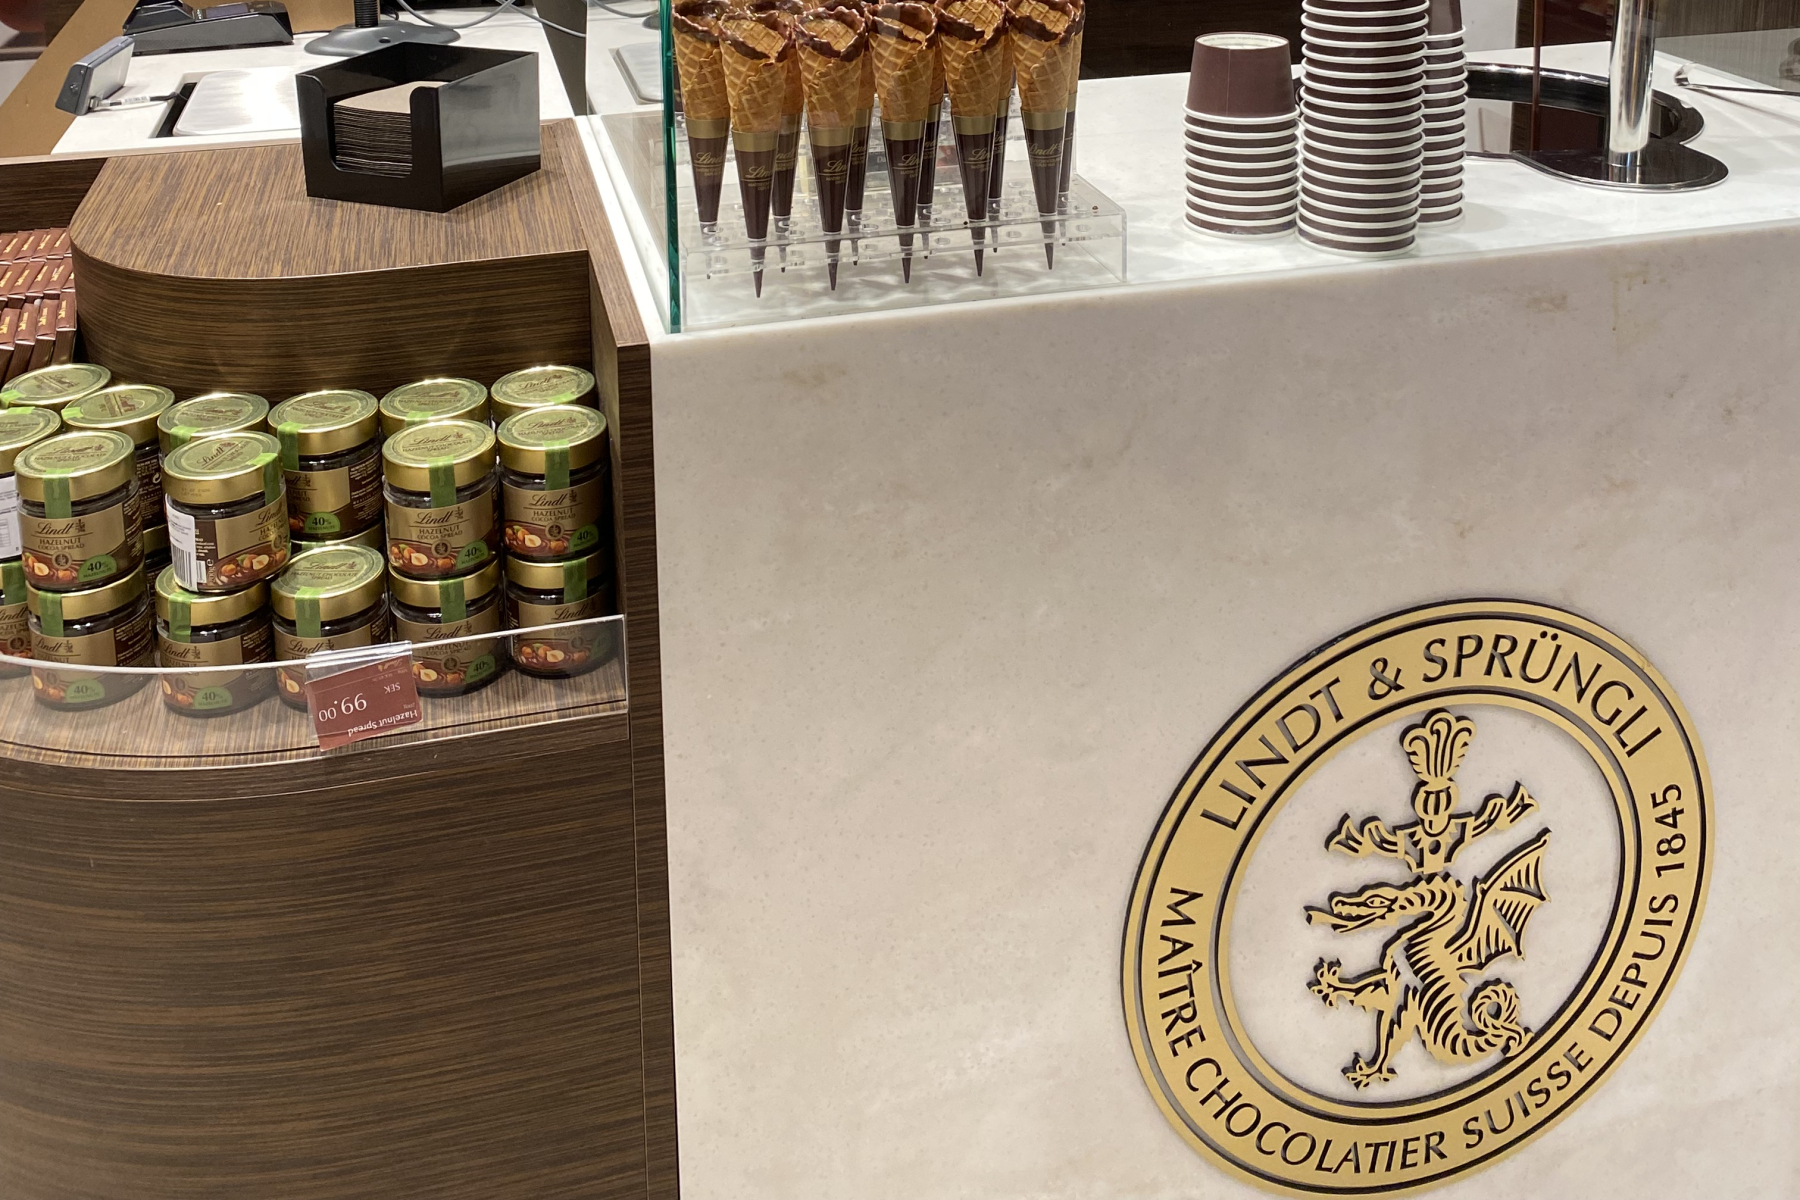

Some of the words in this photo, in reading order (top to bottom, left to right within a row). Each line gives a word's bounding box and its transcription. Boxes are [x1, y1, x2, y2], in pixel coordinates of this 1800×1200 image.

[409, 435, 452, 446] Lindt
[529, 494, 568, 506] Lindt
[415, 511, 453, 524] Lindt
[534, 508, 574, 516] HAZELNUT
[312, 517, 332, 526] 40%
[34, 521, 74, 535] Lindt
[419, 525, 460, 534] HAZELNUT
[441, 530, 462, 538] SPREAD
[40, 537, 81, 545] HAZELNUT
[465, 547, 482, 558] 40%
[88, 560, 110, 571] 40%
[553, 604, 588, 620] Lindt
[425, 625, 463, 639] Lindt
[32, 637, 63, 651] Lindt
[163, 641, 190, 659] Lindt
[288, 639, 323, 653] Lindt
[429, 641, 468, 650] HAZELNUT
[473, 661, 490, 672] 40%
[74, 685, 95, 694] 40%
[384, 682, 400, 694] SEK
[202, 692, 223, 700] 40%
[379, 710, 417, 726] Hazelnut
[347, 721, 378, 737] Spread
[1200, 677, 1354, 831] LINDT
[1367, 656, 1405, 701] &
[1422, 630, 1664, 759] SPRÜNGLI
[1157, 886, 1206, 1059] MAÎTRE
[1185, 1056, 1447, 1175] CHOCOLATIER
[1463, 1042, 1594, 1150] SUISSE
[1590, 896, 1681, 1042] DEPUIS
[1650, 782, 1686, 877] 1845
